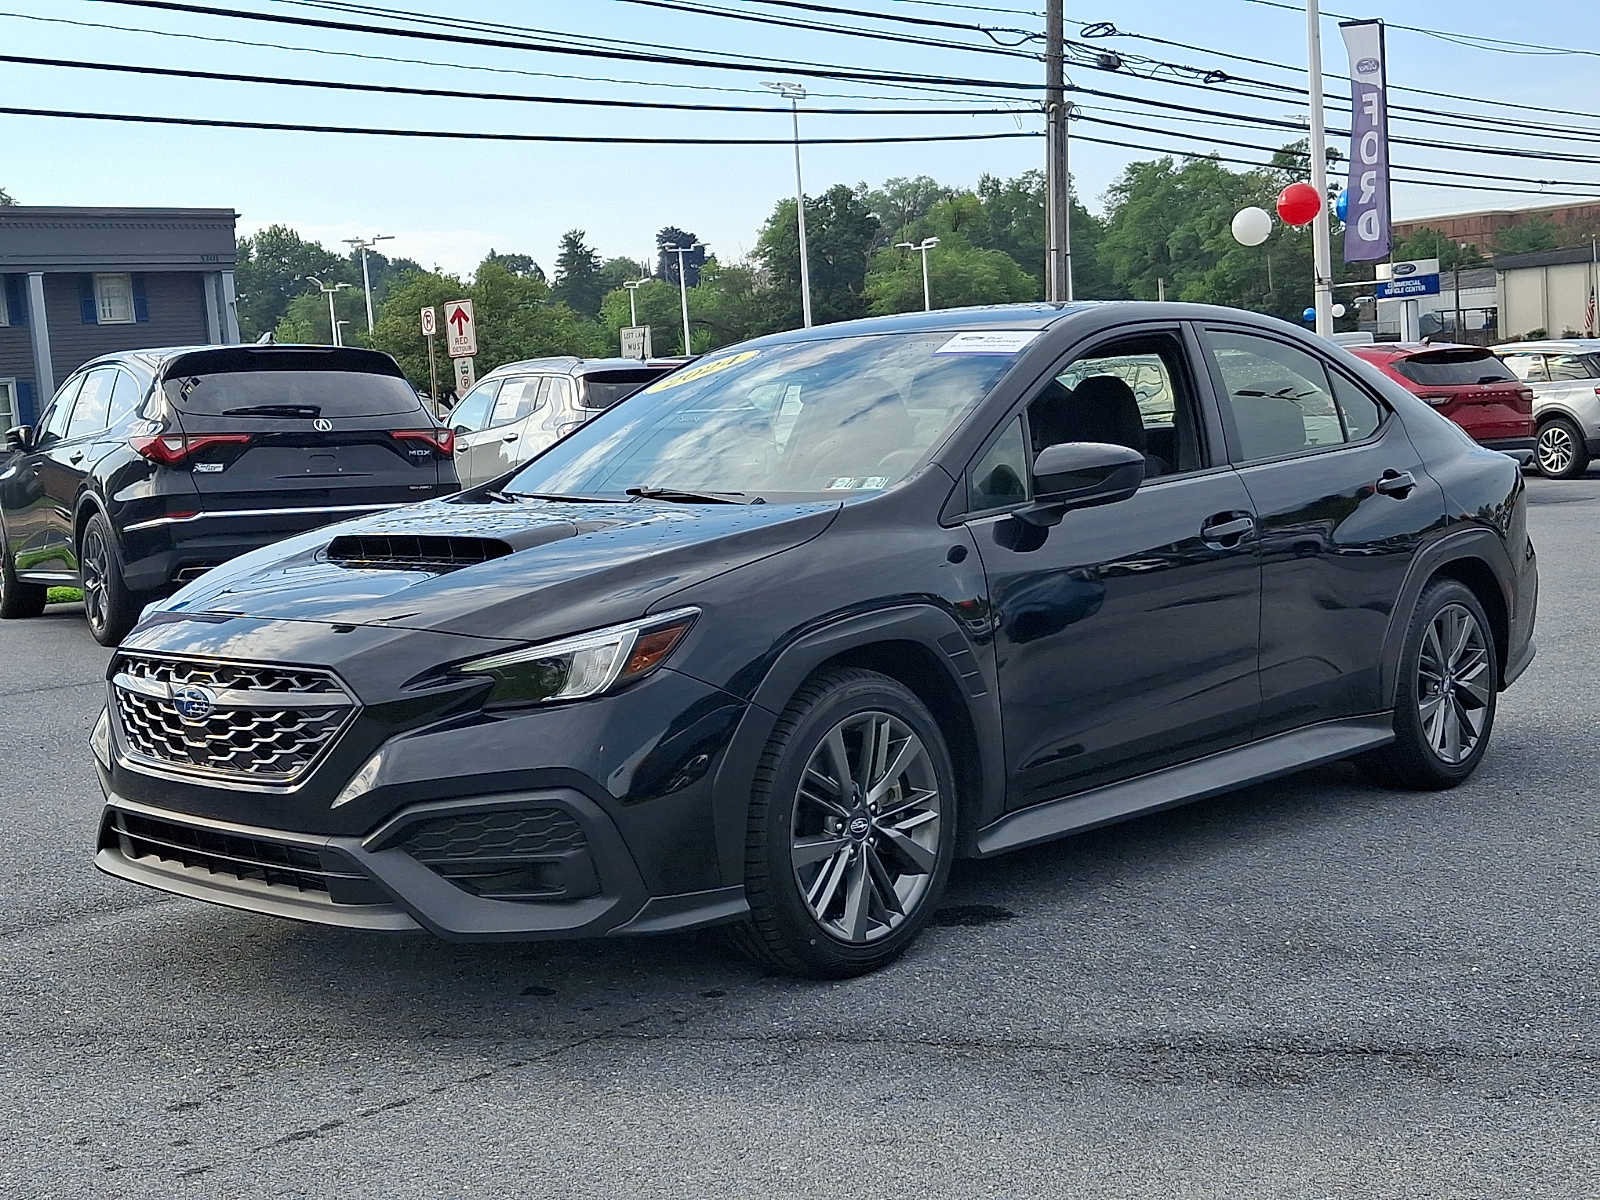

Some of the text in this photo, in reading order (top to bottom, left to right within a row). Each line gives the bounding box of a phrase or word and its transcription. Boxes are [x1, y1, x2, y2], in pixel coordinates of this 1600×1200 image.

[1387, 280, 1422, 289] CMMERCIAL
[1384, 284, 1426, 295] VEICLE CENTER
[454, 336, 469, 345] RED
[452, 345, 472, 353] DETOUR
